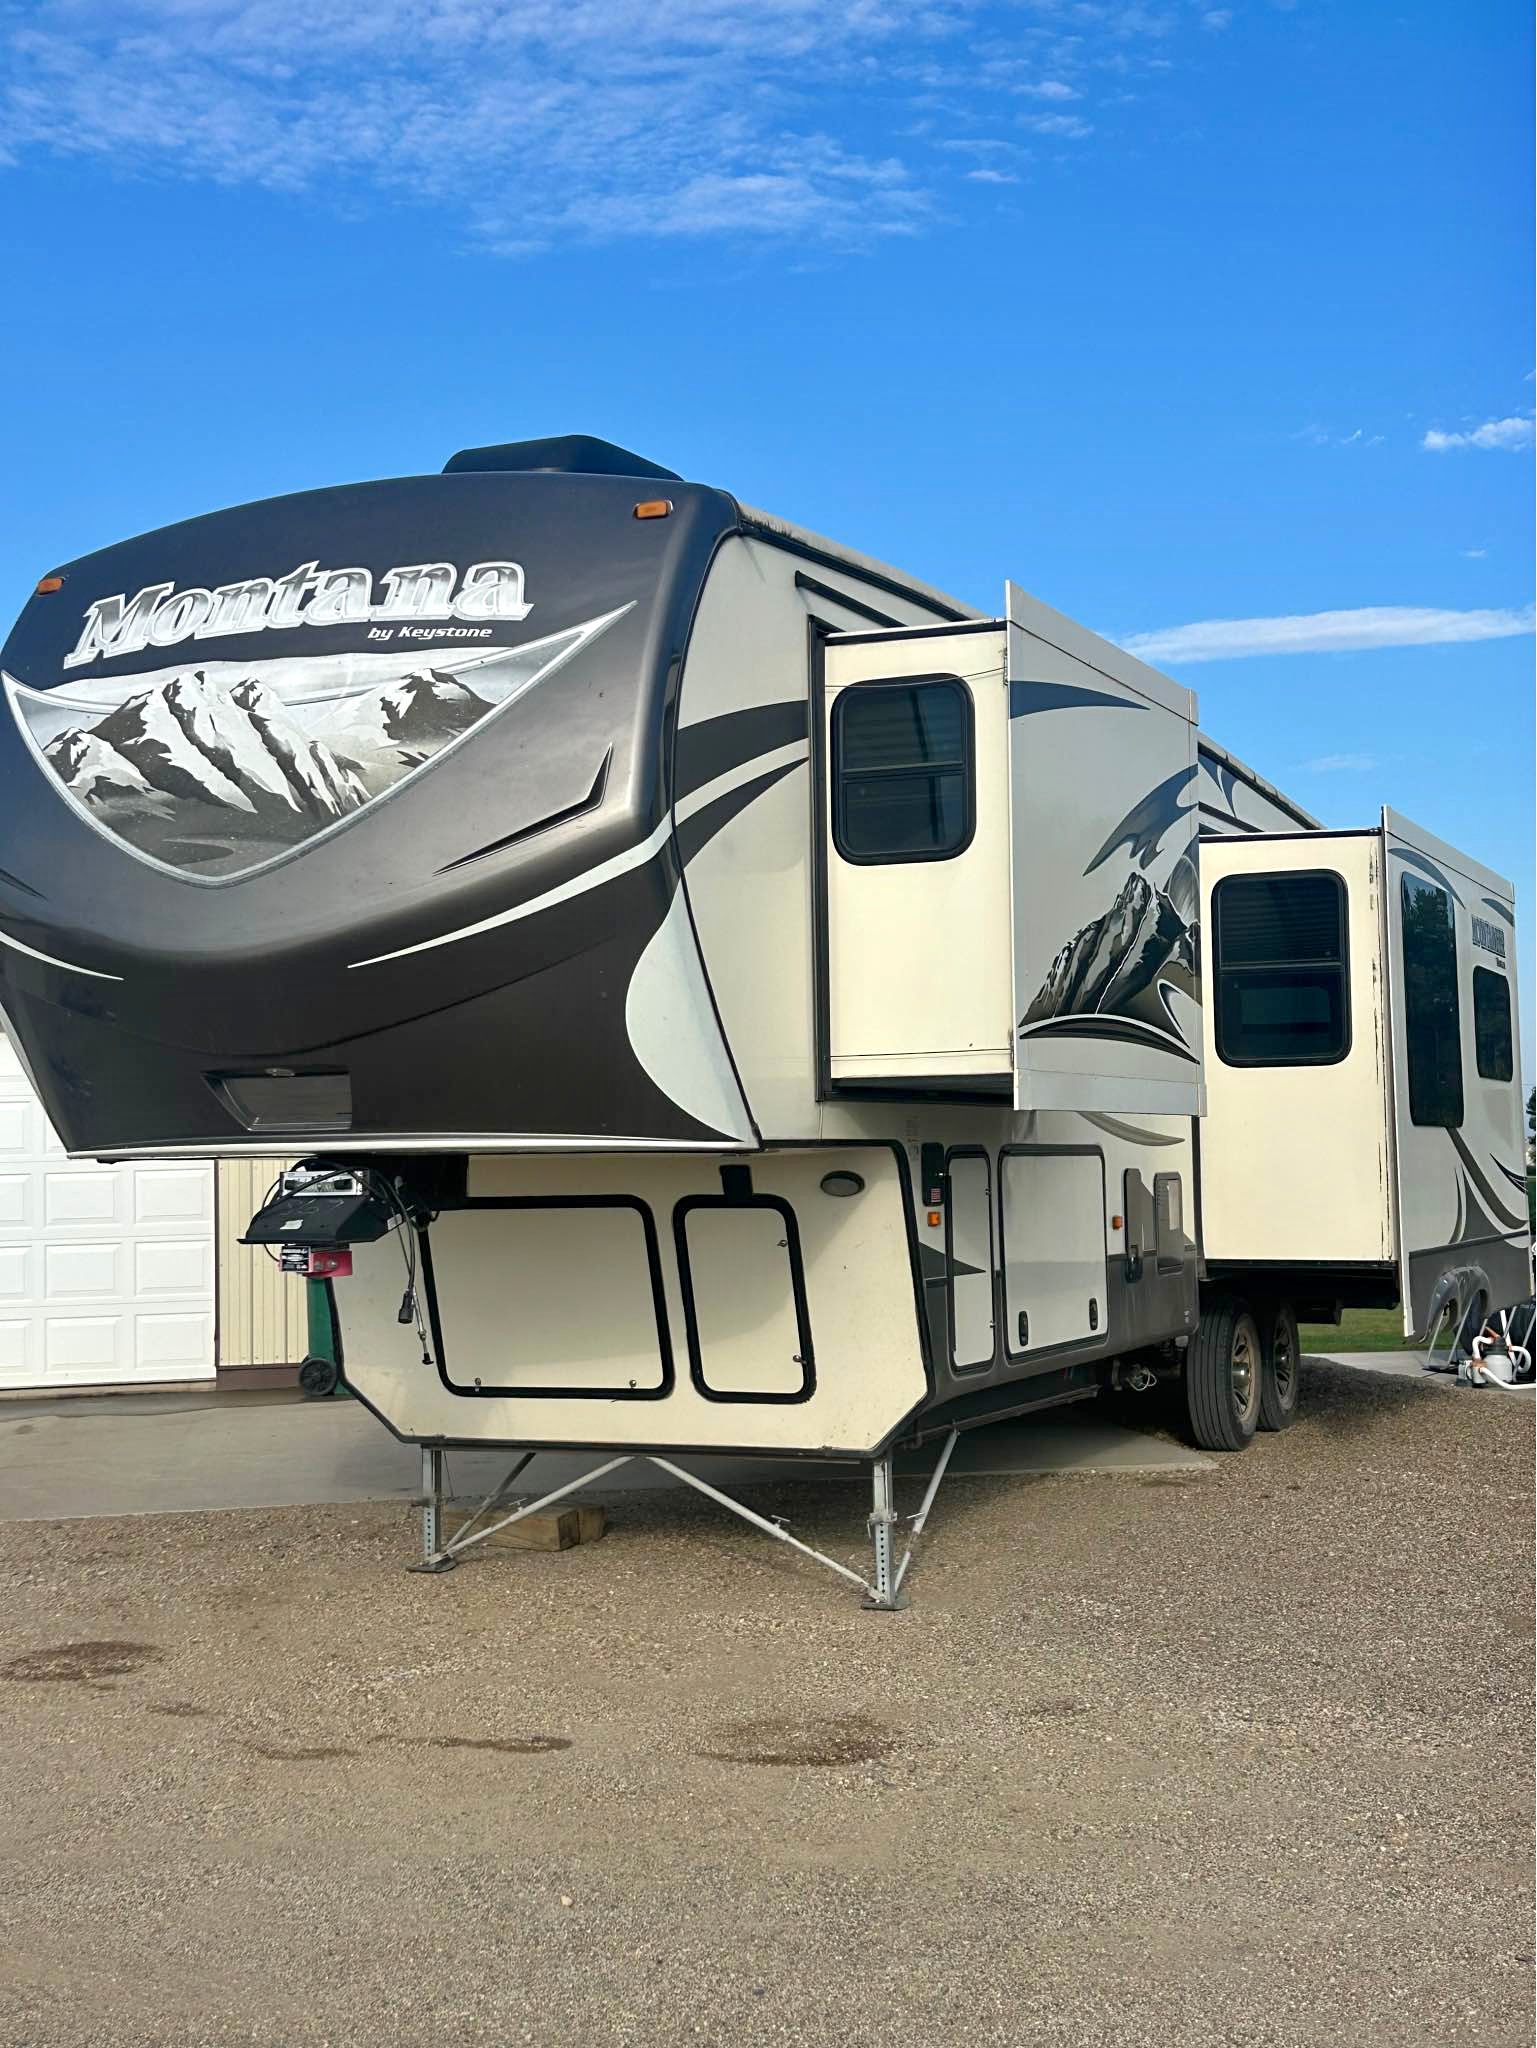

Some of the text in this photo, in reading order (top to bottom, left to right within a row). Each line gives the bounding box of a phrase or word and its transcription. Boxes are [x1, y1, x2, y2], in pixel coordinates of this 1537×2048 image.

[64, 560, 534, 669] Montana
[367, 626, 493, 641] by Keystone
